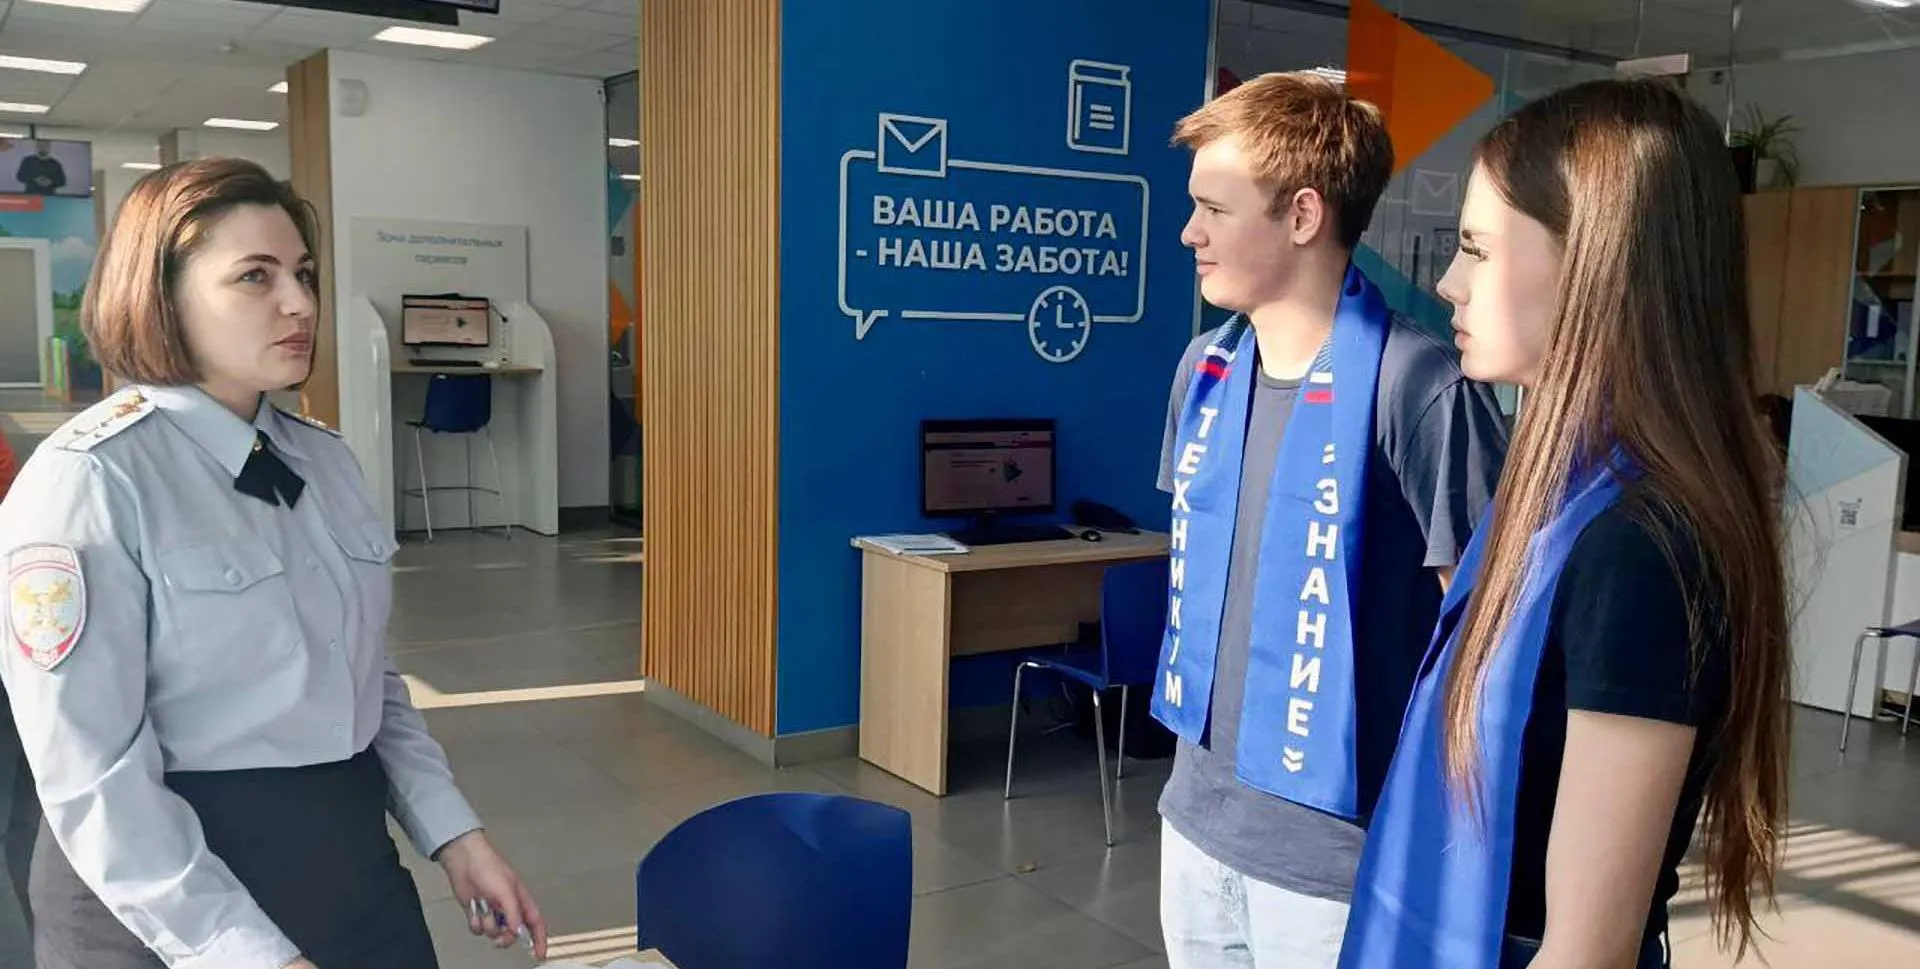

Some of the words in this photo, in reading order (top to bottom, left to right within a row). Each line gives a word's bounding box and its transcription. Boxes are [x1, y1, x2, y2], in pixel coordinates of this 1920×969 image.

[873, 195, 980, 231] ВАША
[989, 204, 1118, 239] РАБОТА
[878, 237, 987, 271] НАША
[995, 243, 1129, 277] ЗАБОТА!
[1164, 406, 1219, 708] ТЕХНИКУМ
